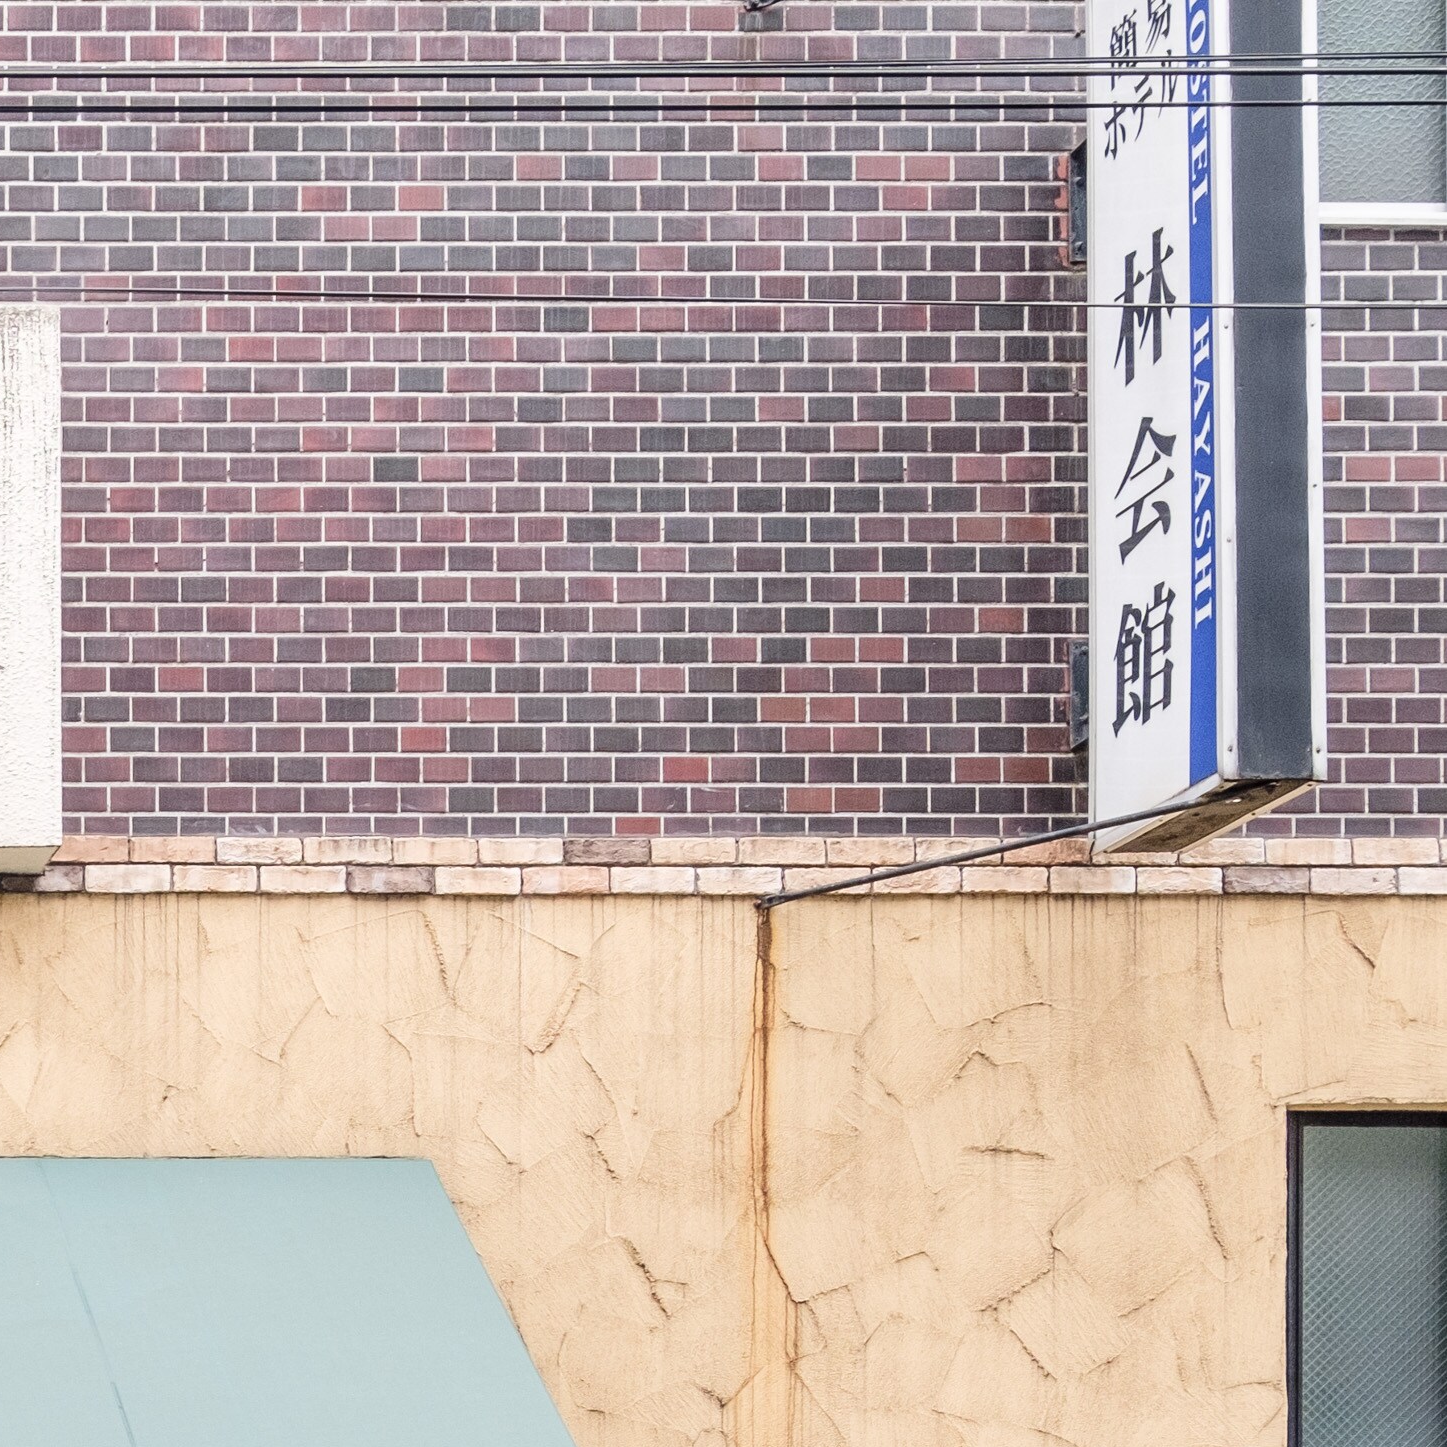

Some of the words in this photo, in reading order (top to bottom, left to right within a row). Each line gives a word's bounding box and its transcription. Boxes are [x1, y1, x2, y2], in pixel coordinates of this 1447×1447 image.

[1103, 48, 1182, 161] ホテル
[1188, 0, 1208, 226] OSTEL
[1112, 226, 1178, 739] 林会館
[1192, 315, 1214, 630] HAYASHI
